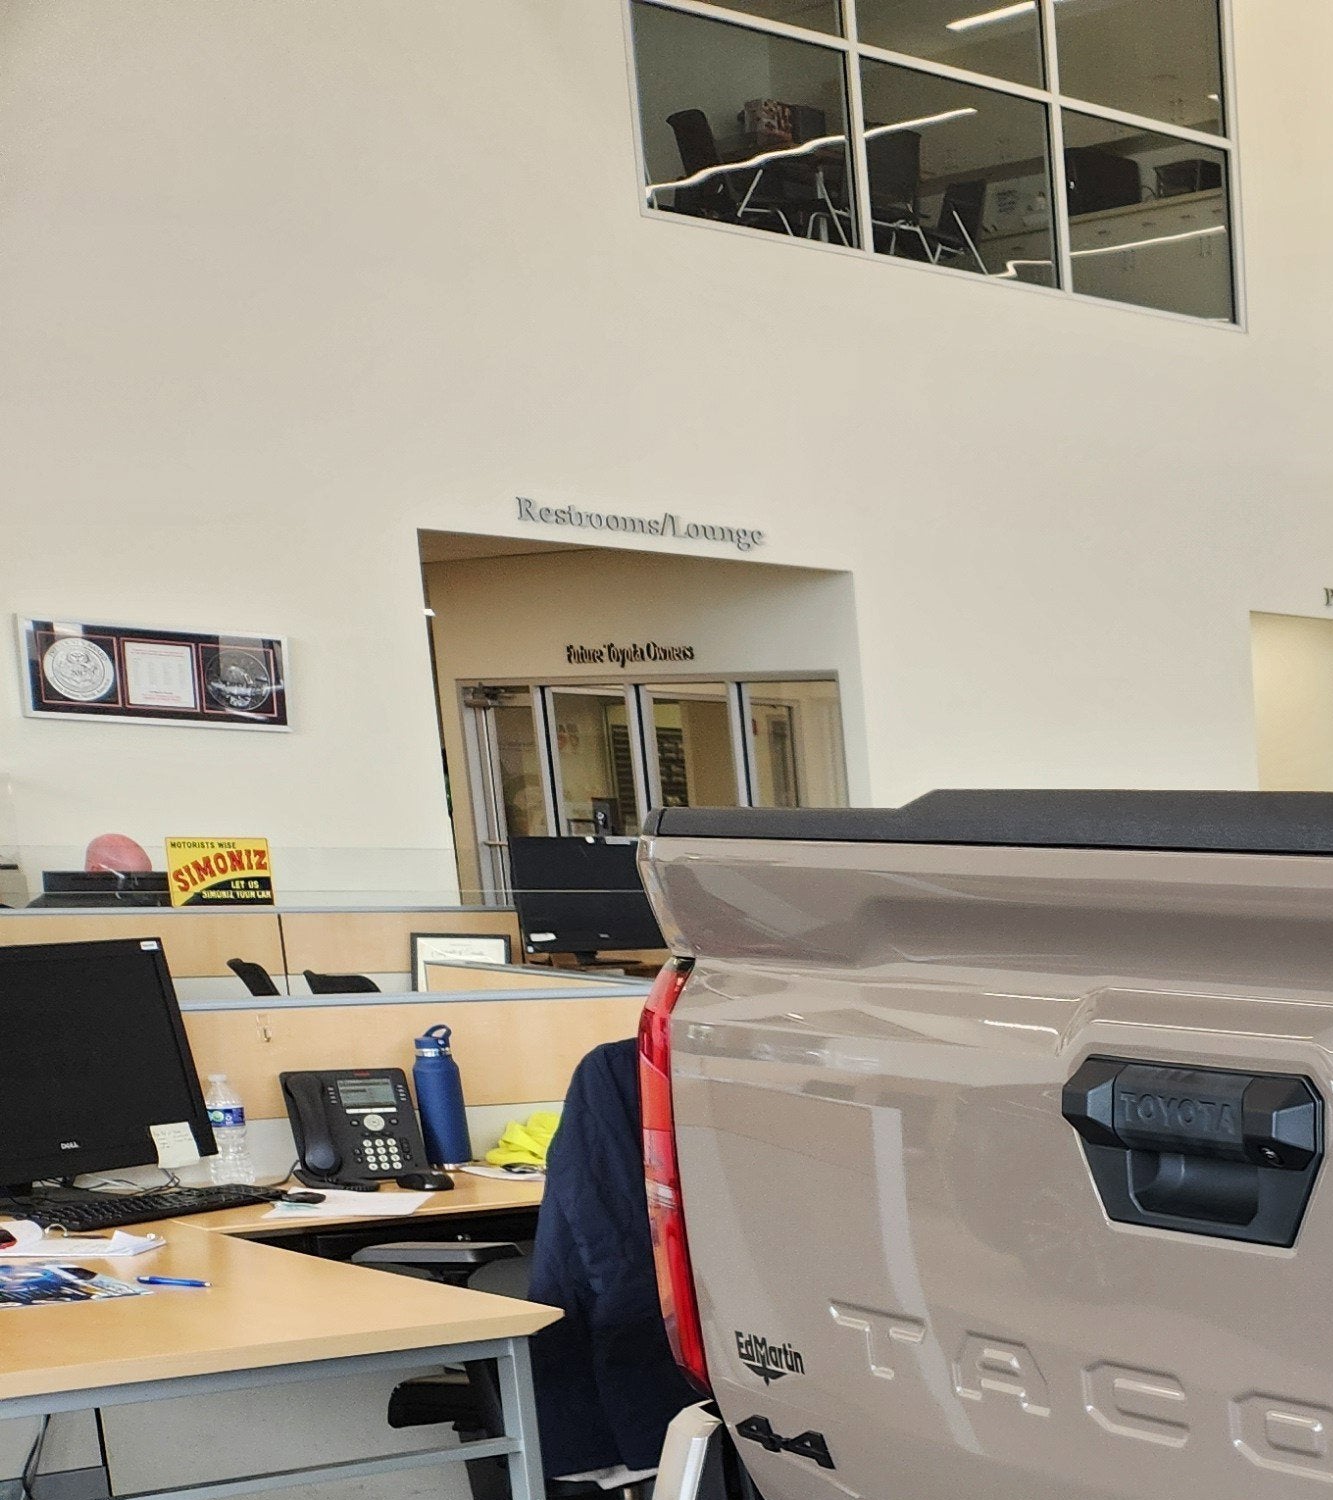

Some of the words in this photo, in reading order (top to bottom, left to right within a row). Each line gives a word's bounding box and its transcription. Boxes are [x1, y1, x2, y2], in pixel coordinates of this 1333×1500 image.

[515, 496, 766, 551] Restrooms/Lounge
[566, 644, 603, 664] Future
[603, 642, 646, 668] Toyota
[646, 641, 695, 662] Owners
[170, 841, 215, 849] MOTORISTS
[217, 841, 237, 849] WISE
[172, 849, 268, 892] SIMONIZ
[231, 880, 245, 889] LET
[248, 880, 260, 889] US
[1119, 1090, 1236, 1136] TOYOTA
[60, 1141, 79, 1150] DELL
